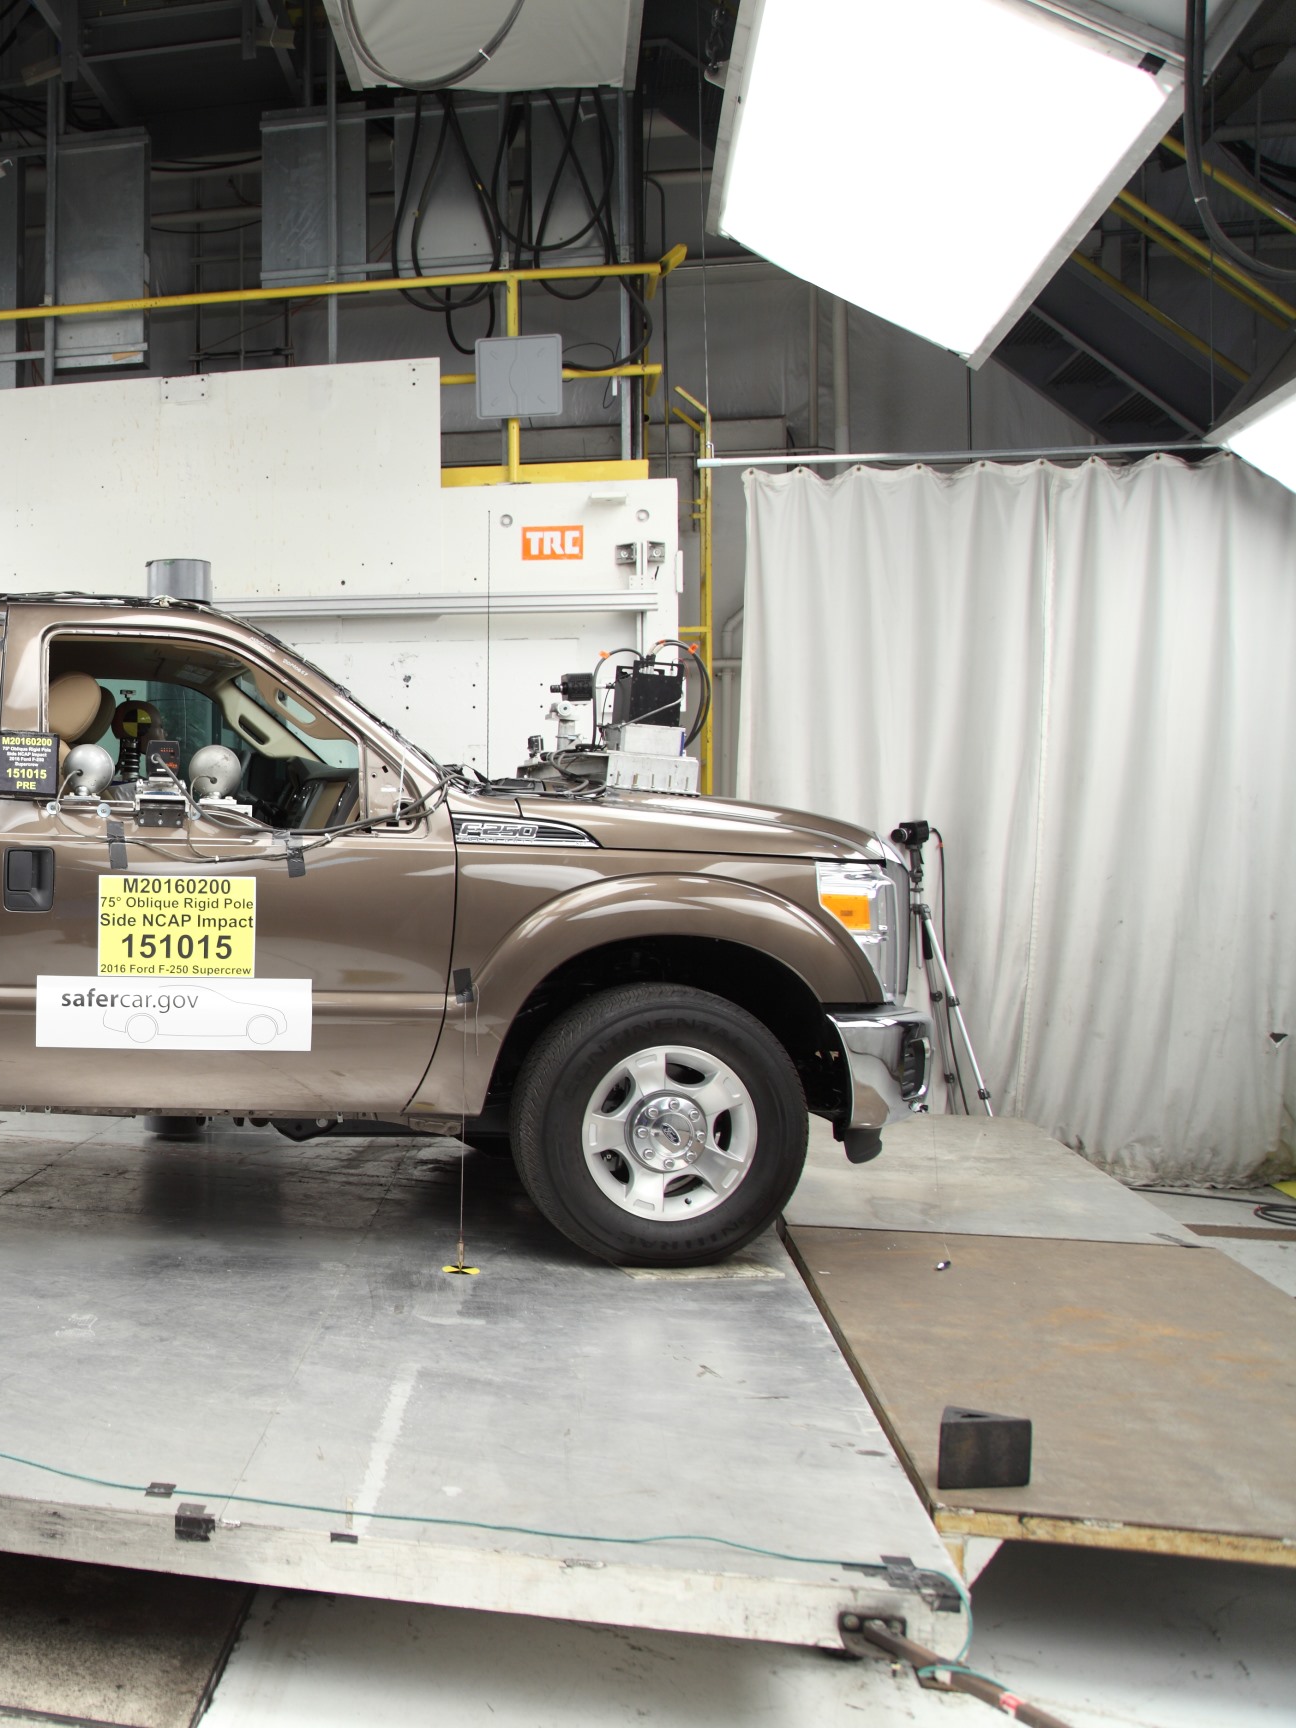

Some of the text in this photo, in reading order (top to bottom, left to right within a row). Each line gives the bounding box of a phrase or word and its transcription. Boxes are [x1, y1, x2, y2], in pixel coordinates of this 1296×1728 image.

[526, 530, 580, 555] TRC
[2, 737, 52, 746] M20160200
[7, 768, 47, 779] 151015
[16, 781, 36, 789] PRE
[123, 878, 231, 894] M20160200
[100, 897, 254, 911] 75° Oblique Rigid Pole
[100, 913, 254, 931] Side NCAP Impact
[121, 933, 233, 960] 151015
[100, 964, 252, 976] 2016 Ford F-250 Supercrew
[61, 988, 199, 1013] safercar.gov
